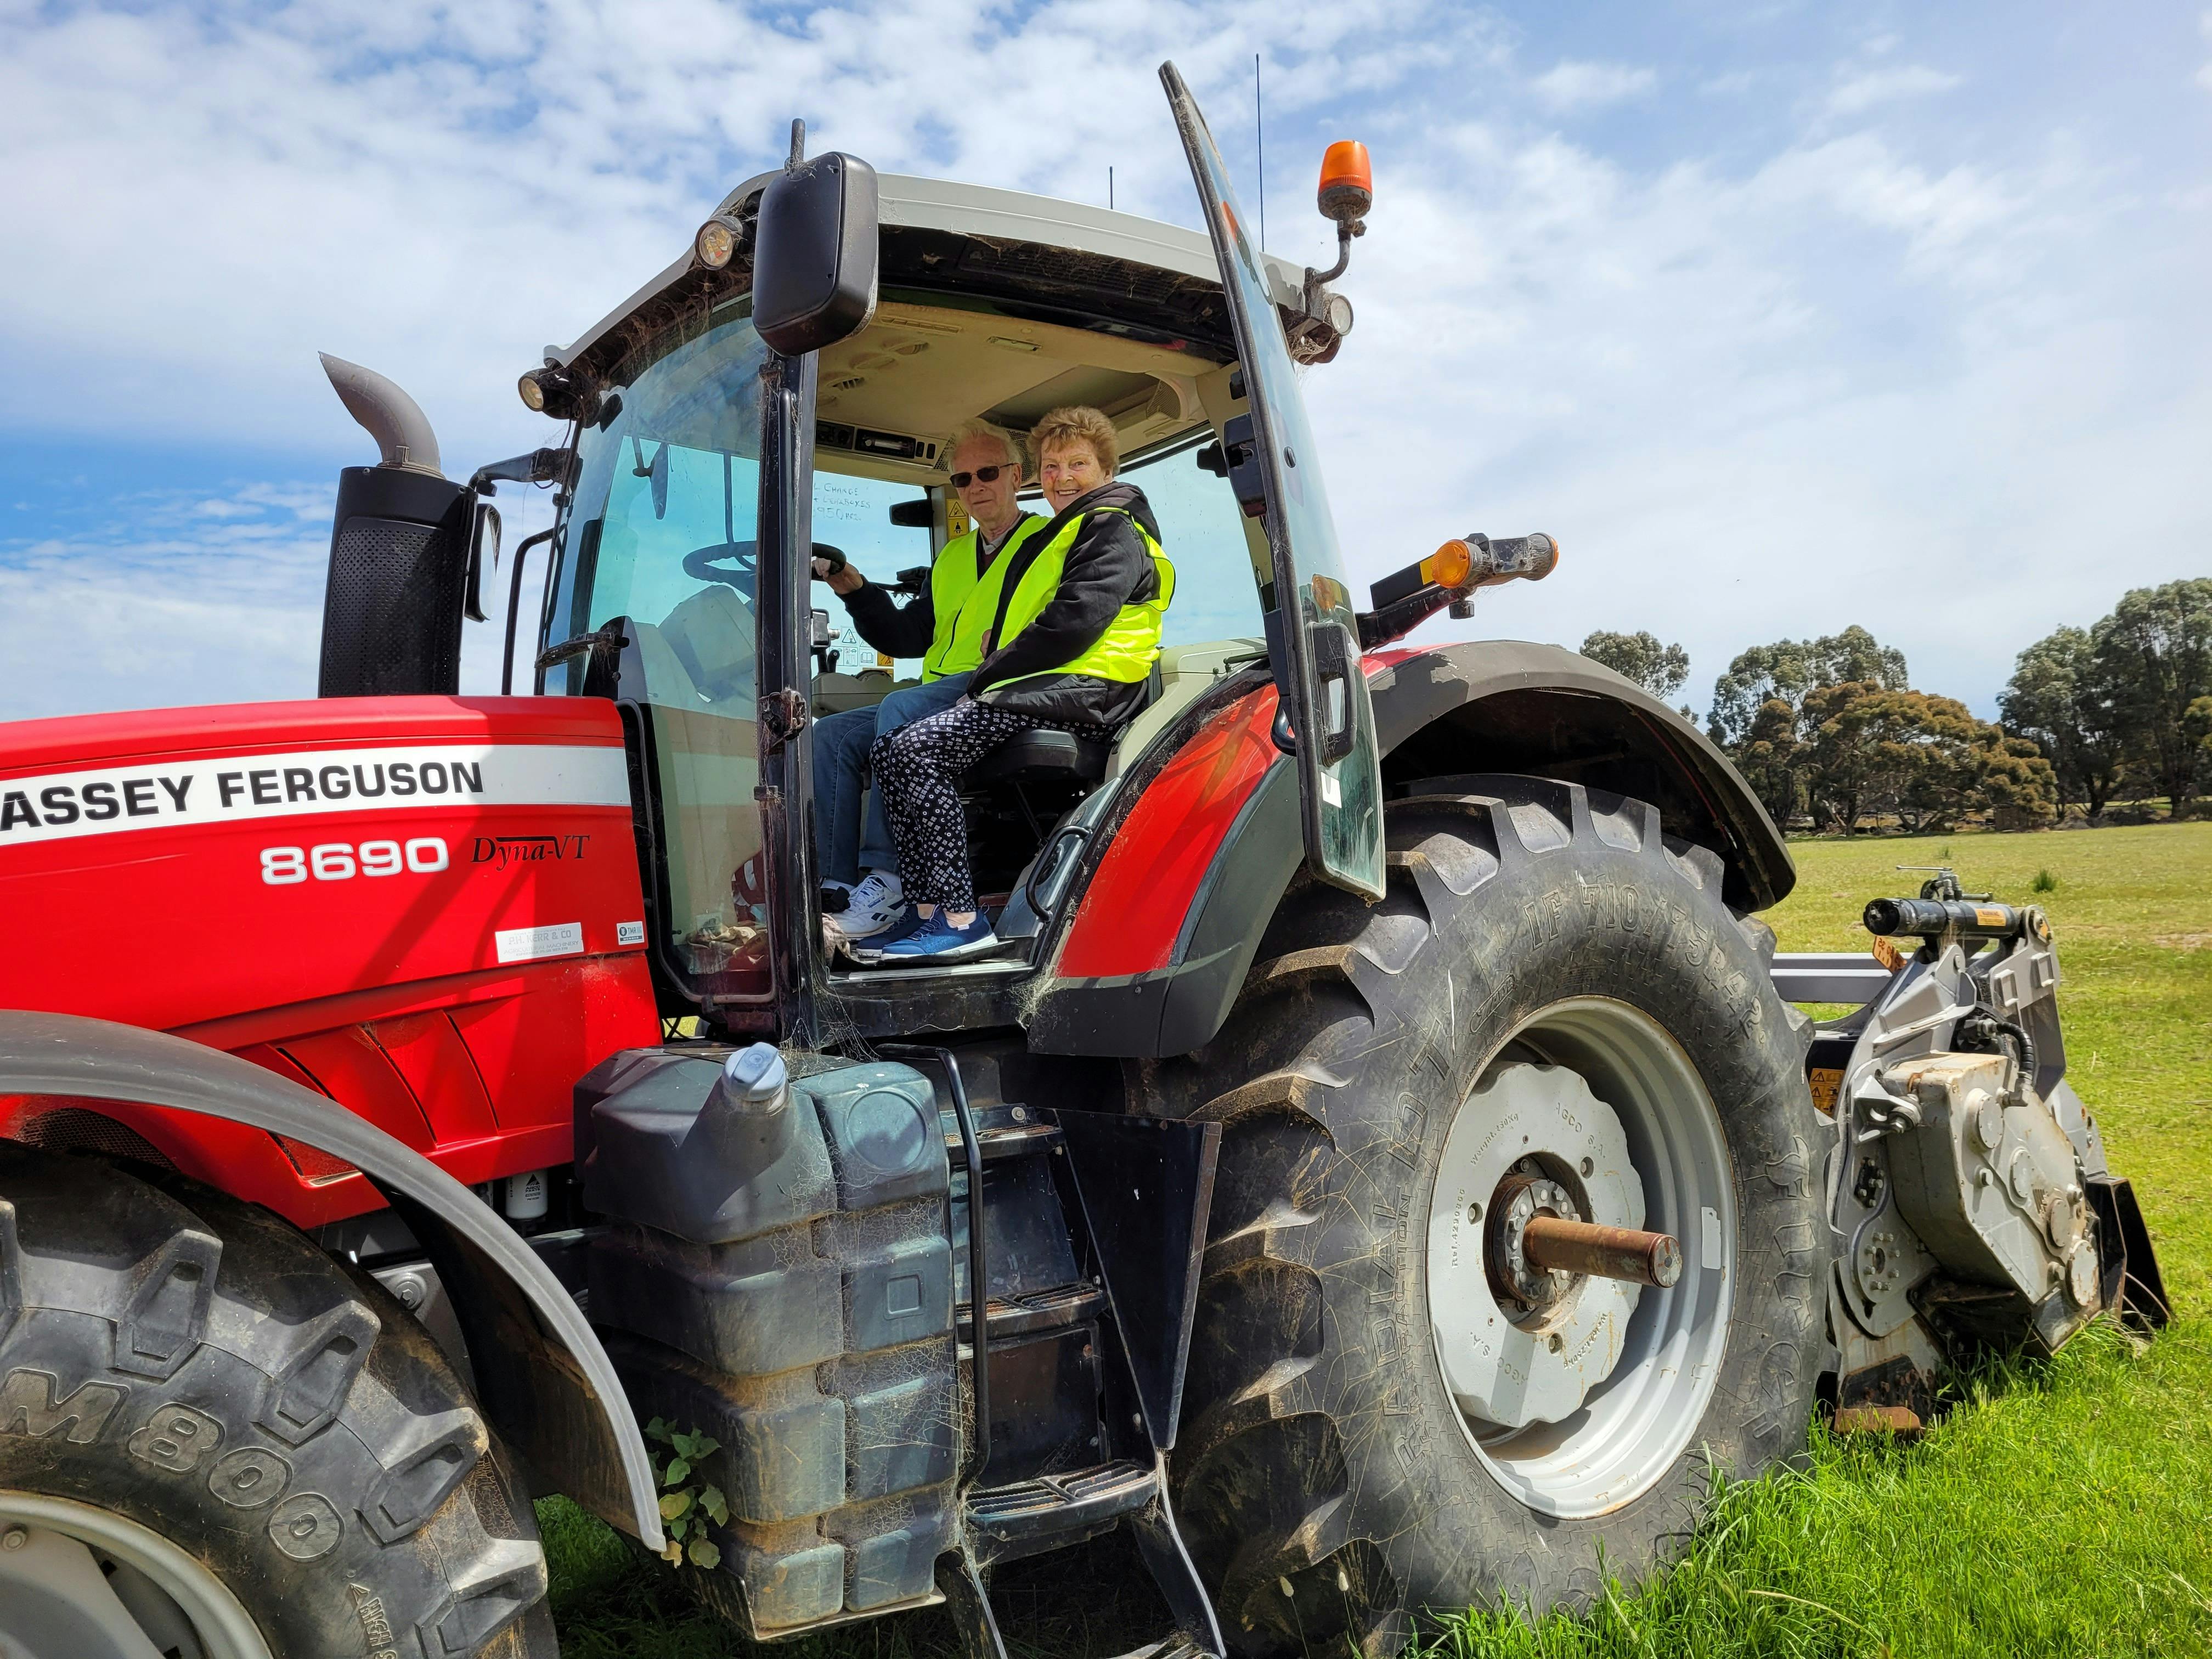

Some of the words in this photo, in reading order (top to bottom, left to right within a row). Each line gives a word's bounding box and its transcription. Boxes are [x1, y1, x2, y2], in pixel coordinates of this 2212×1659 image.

[824, 483, 859, 496] CHANGE
[0, 775, 194, 831] ASSEY
[217, 762, 484, 808] FERGUSON
[260, 837, 449, 885] 8690
[470, 835, 590, 871] Dyna-VT
[504, 945, 545, 954] AGRICULTURAL
[546, 940, 579, 949] MACHINERY
[527, 933, 549, 943] KERR
[552, 932, 558, 940] &
[561, 930, 571, 938] CO
[1556, 1102, 1582, 1132] AGCO
